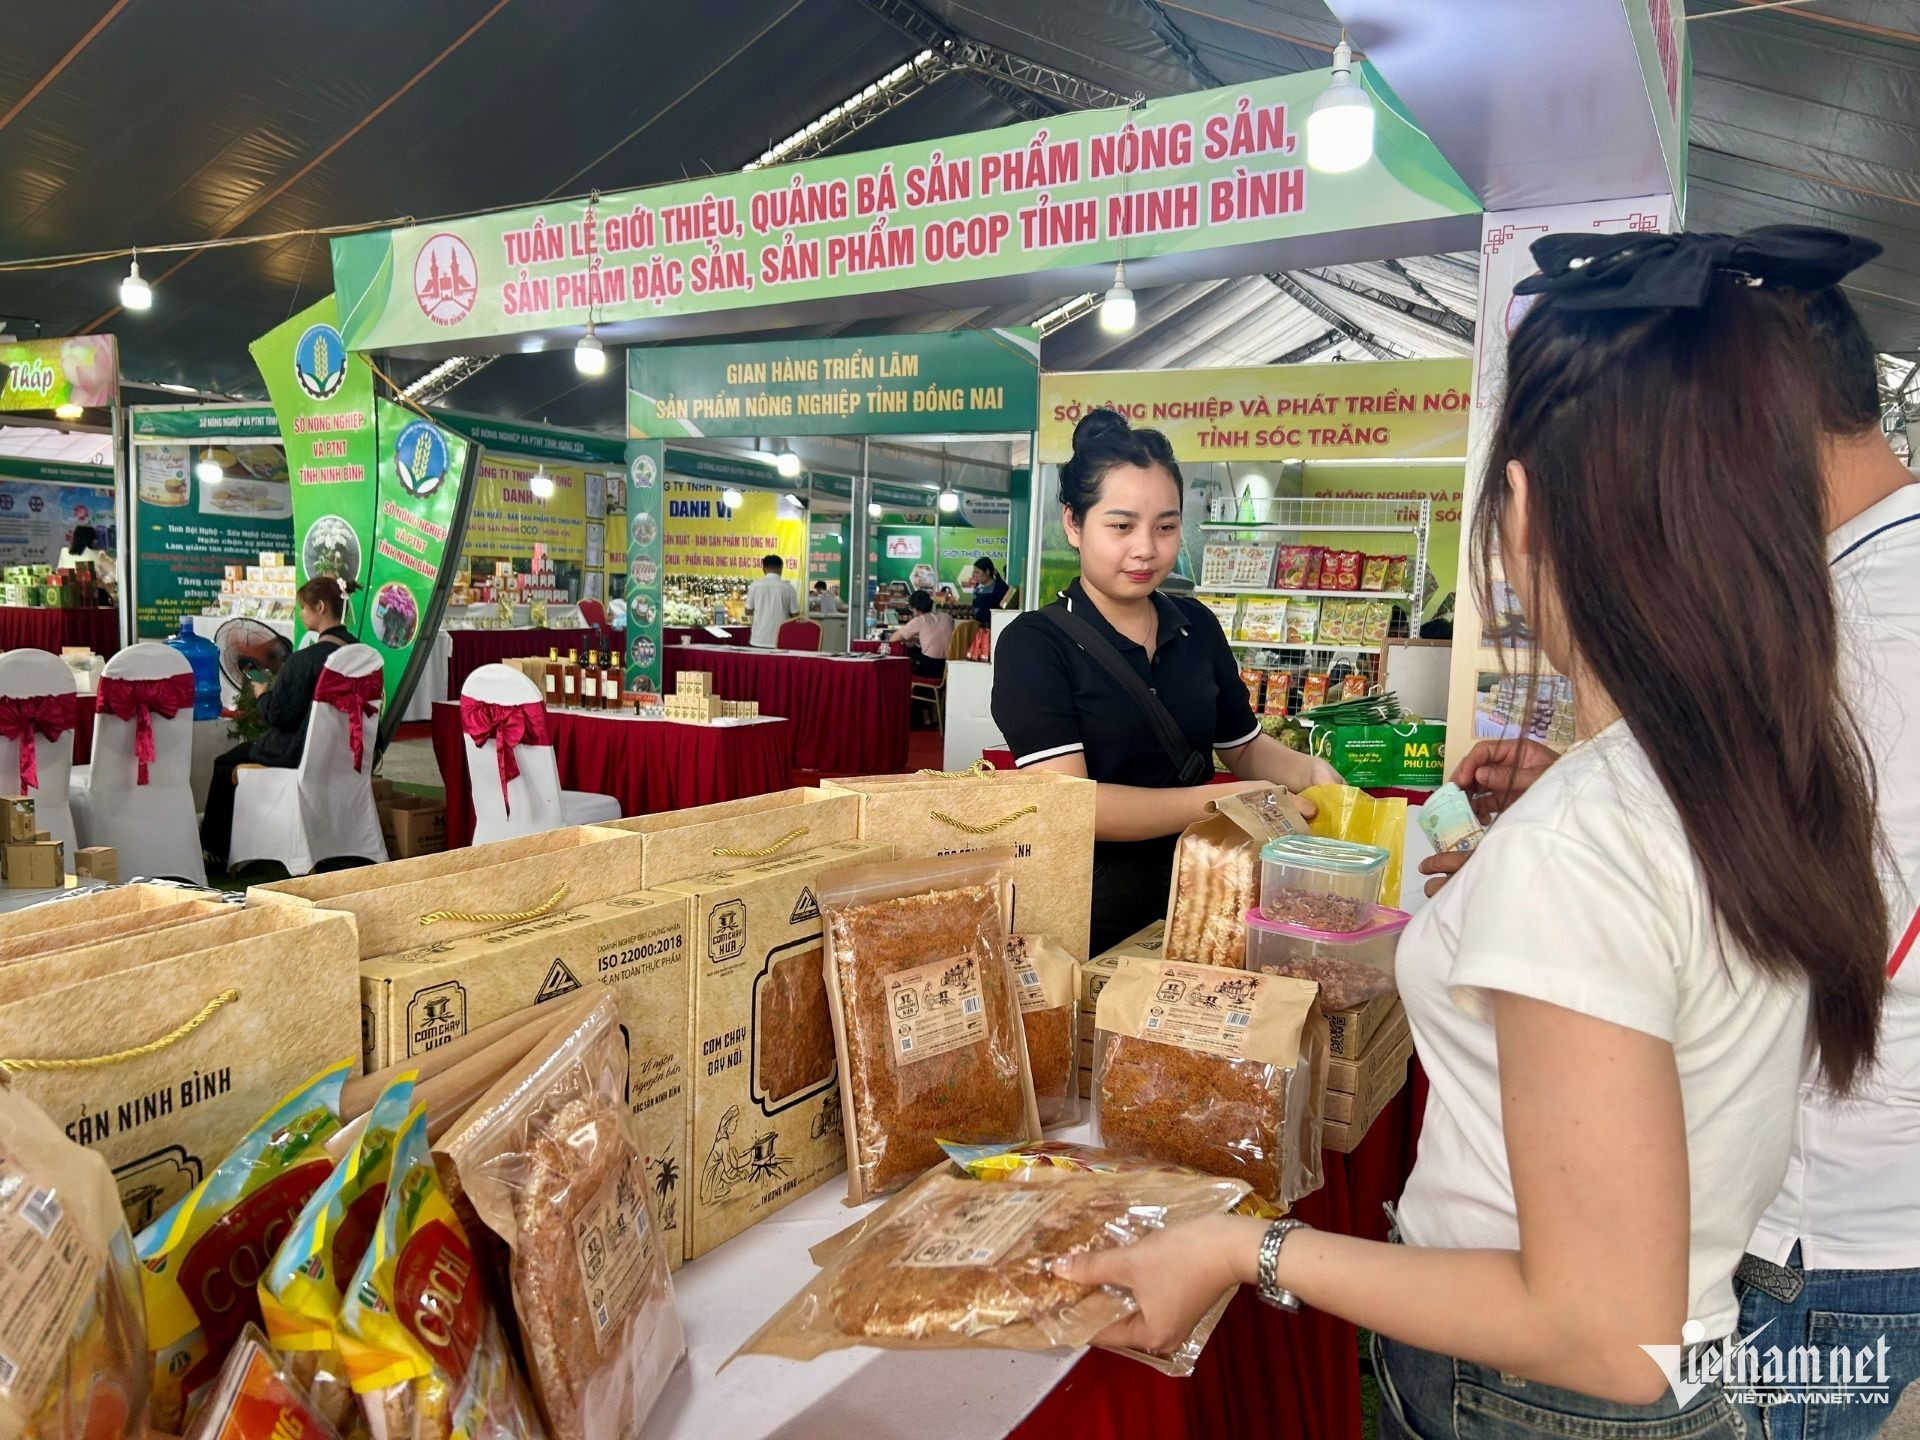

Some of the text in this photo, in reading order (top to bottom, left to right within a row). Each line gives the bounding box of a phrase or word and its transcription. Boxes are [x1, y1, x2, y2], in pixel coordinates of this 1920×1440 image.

[504, 99, 1296, 265] TUẦN LỄ GIỚI THIỆU, QUẢNG BÁ SẢN PHẨM NÔNG SẢN,
[504, 168, 1304, 314] SẢN PHẨM ĐẶC SẢN, SẢN PHẨM OCOP TỈNH NINH BÌNH
[11, 361, 53, 394] Tháp
[727, 348, 918, 384] GIAN HÀNG TRIỂN LÃM
[656, 382, 1003, 420] SẢN PHẨM NÔNG NGHIỆP TỈNH ĐỒNG NAI
[1054, 399, 1082, 421] SỞ
[1152, 397, 1232, 422] NGHIỆP
[1244, 395, 1270, 417] VÀ
[1278, 392, 1340, 415] PHÁT
[1344, 389, 1416, 414] TRIỂN
[1424, 391, 1472, 410] NÔN
[313, 438, 347, 458] VÀ PTNT
[1198, 425, 1389, 448] TỈNH SÓC TRĂNG
[321, 466, 341, 483] NINH
[344, 463, 364, 482] BÌNH
[503, 487, 533, 504] DANH
[673, 481, 684, 491] TY
[1429, 489, 1448, 501] VÀ
[669, 500, 711, 518] DANH
[1394, 506, 1431, 522] TỈN
[1404, 743, 1429, 757] NA
[1404, 758, 1422, 768] PHÚ
[598, 934, 682, 972] ISO 22000:2018
[609, 972, 620, 984] AN
[620, 966, 641, 980] TOÀN
[724, 1022, 747, 1048] CHÁY
[707, 1045, 742, 1076] ĐÁY NỒI
[65, 1067, 231, 1147] SẢN NINH BÌNH
[414, 1245, 471, 1347] COCHI
